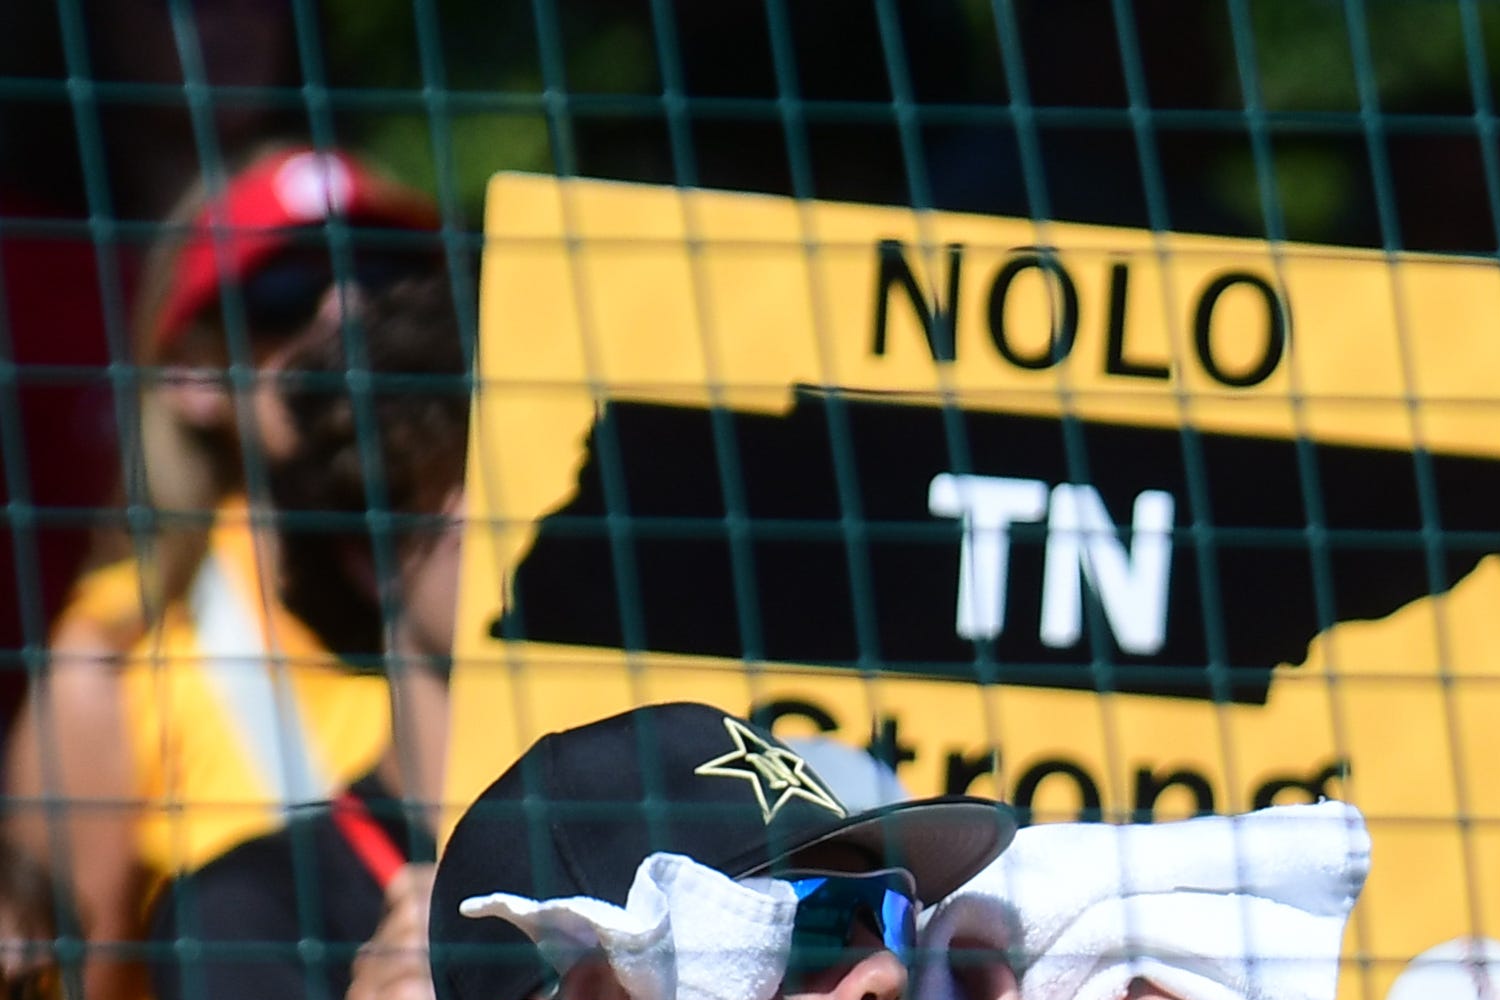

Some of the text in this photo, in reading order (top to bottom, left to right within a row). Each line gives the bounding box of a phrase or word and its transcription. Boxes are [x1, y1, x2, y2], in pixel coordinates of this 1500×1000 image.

[872, 239, 1286, 388] NOLO
[928, 472, 1175, 656] TN
[749, 697, 1351, 827] tron
